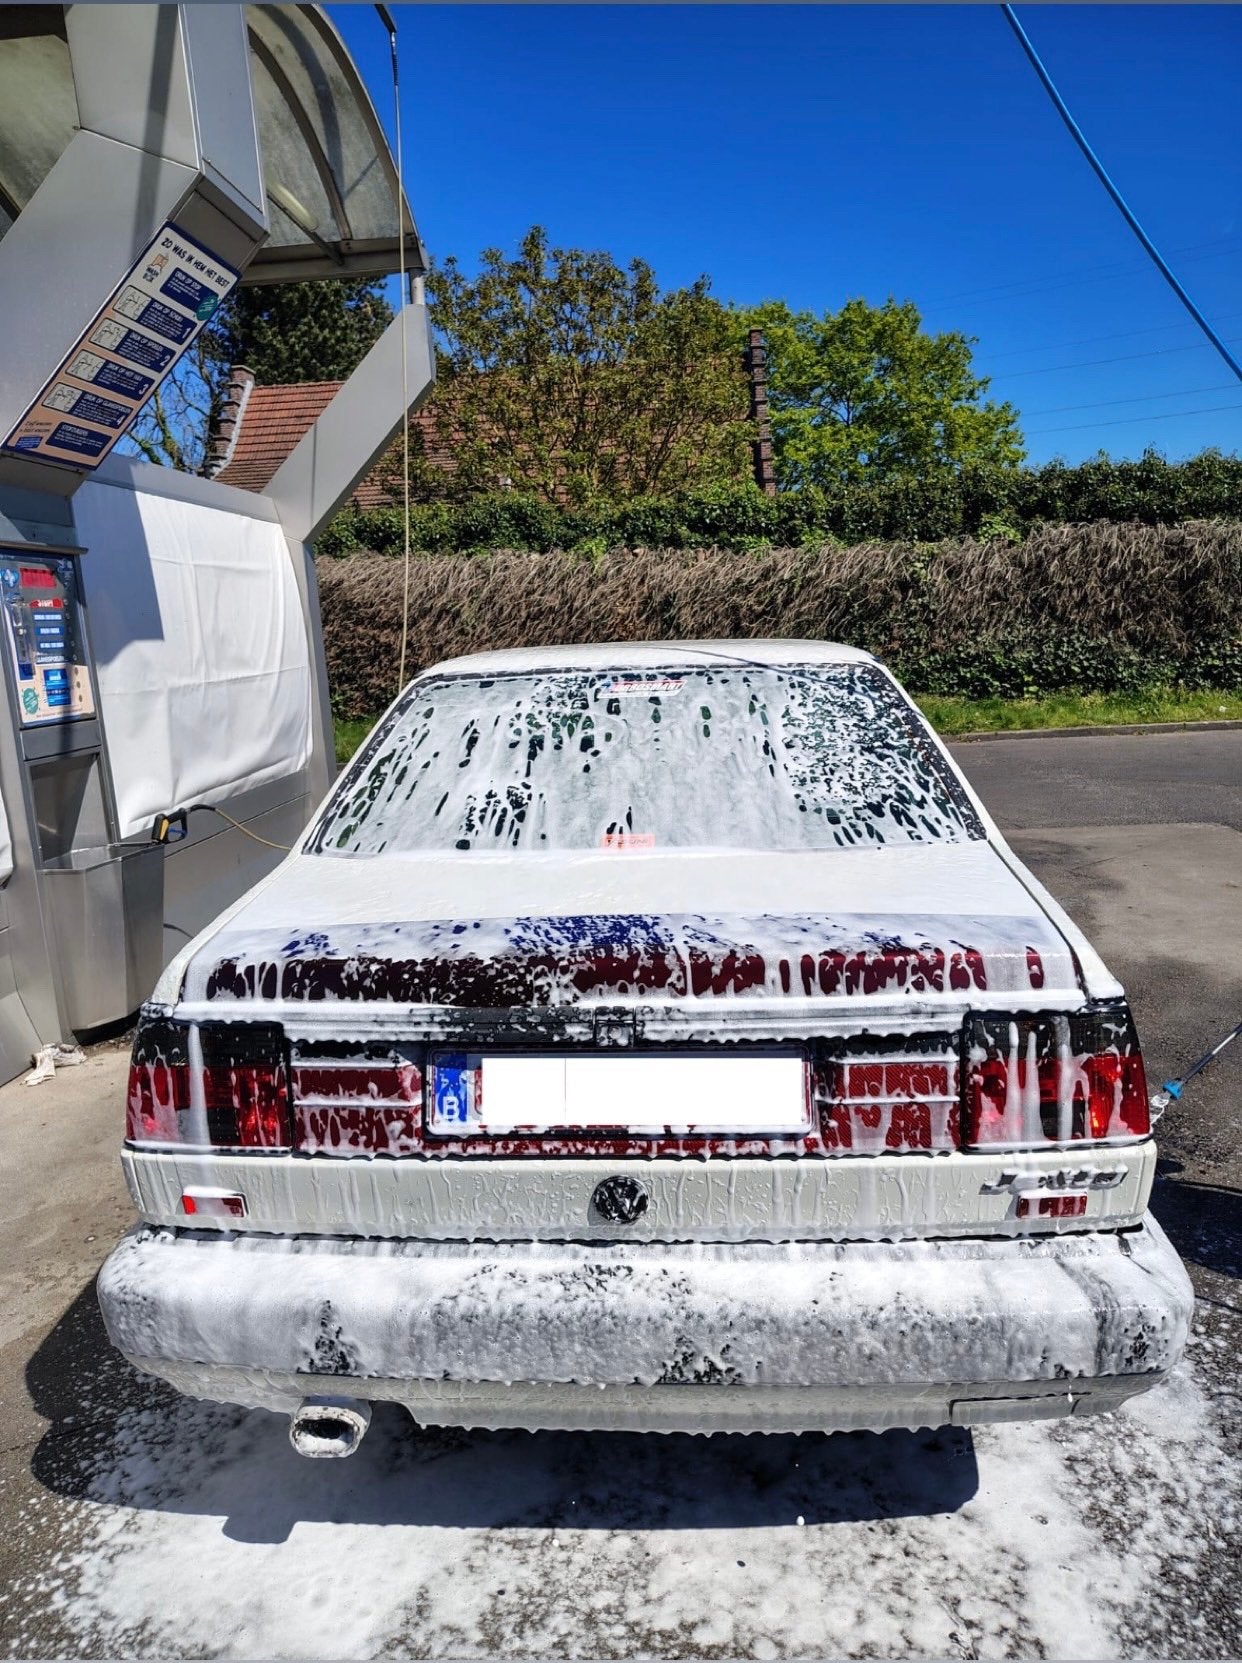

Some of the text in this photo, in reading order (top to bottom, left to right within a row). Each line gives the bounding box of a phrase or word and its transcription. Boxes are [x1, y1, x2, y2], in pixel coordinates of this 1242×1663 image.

[161, 236, 230, 288] ZO WAS IK HEM HET BEST
[180, 327, 191, 338] 1
[158, 354, 171, 366] 2
[137, 383, 149, 395] 3
[443, 1096, 459, 1119] B
